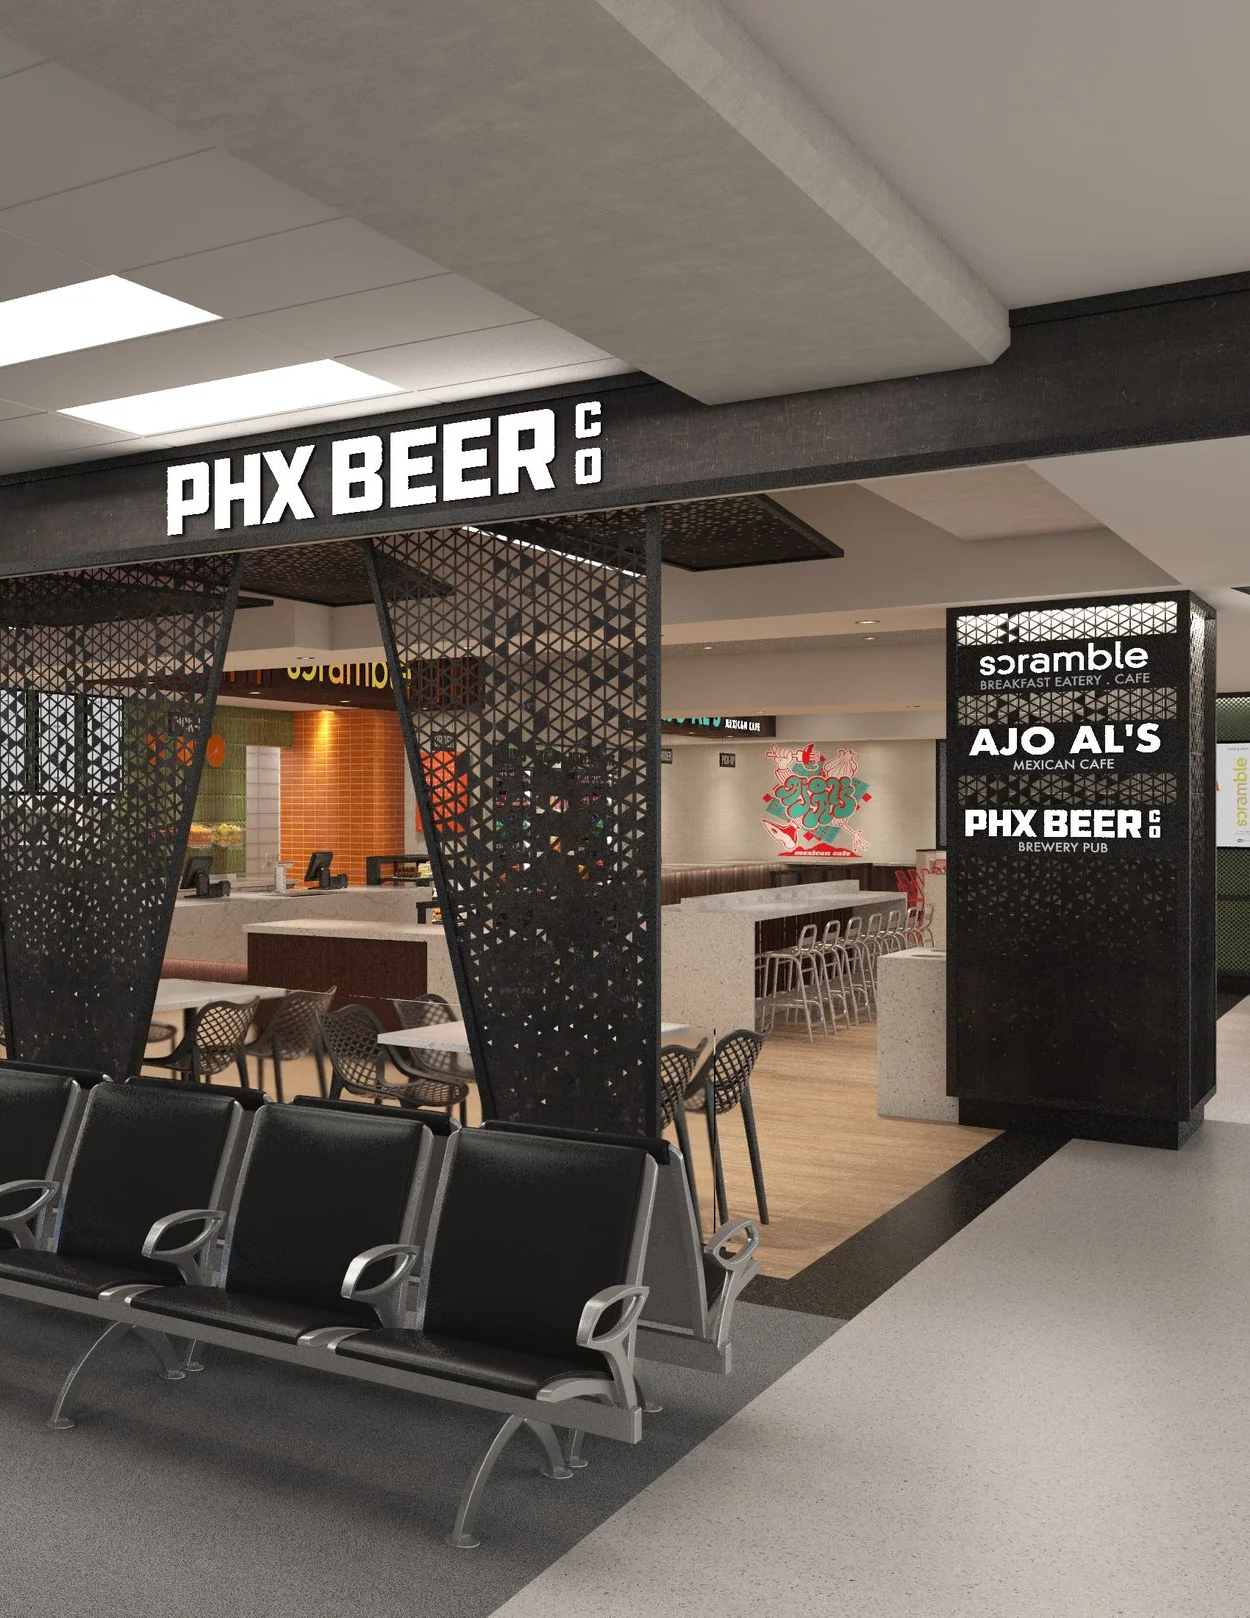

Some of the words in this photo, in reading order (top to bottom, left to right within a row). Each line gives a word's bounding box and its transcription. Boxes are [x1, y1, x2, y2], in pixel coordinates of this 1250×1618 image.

[167, 443, 316, 537] PHX
[331, 408, 556, 516] BEER
[980, 677, 1051, 691] BREAKFAST
[1054, 674, 1102, 688] EATERY
[1114, 672, 1151, 685] CAFE
[968, 727, 1055, 756] AJO
[1069, 723, 1161, 755] AL'S
[1012, 759, 1075, 771] MEXICAN
[1079, 758, 1115, 770] CAFE
[964, 809, 1038, 838] PHX
[1043, 809, 1142, 839] BEER
[1018, 841, 1079, 854] BREWERY
[1082, 841, 1109, 854] PUB
